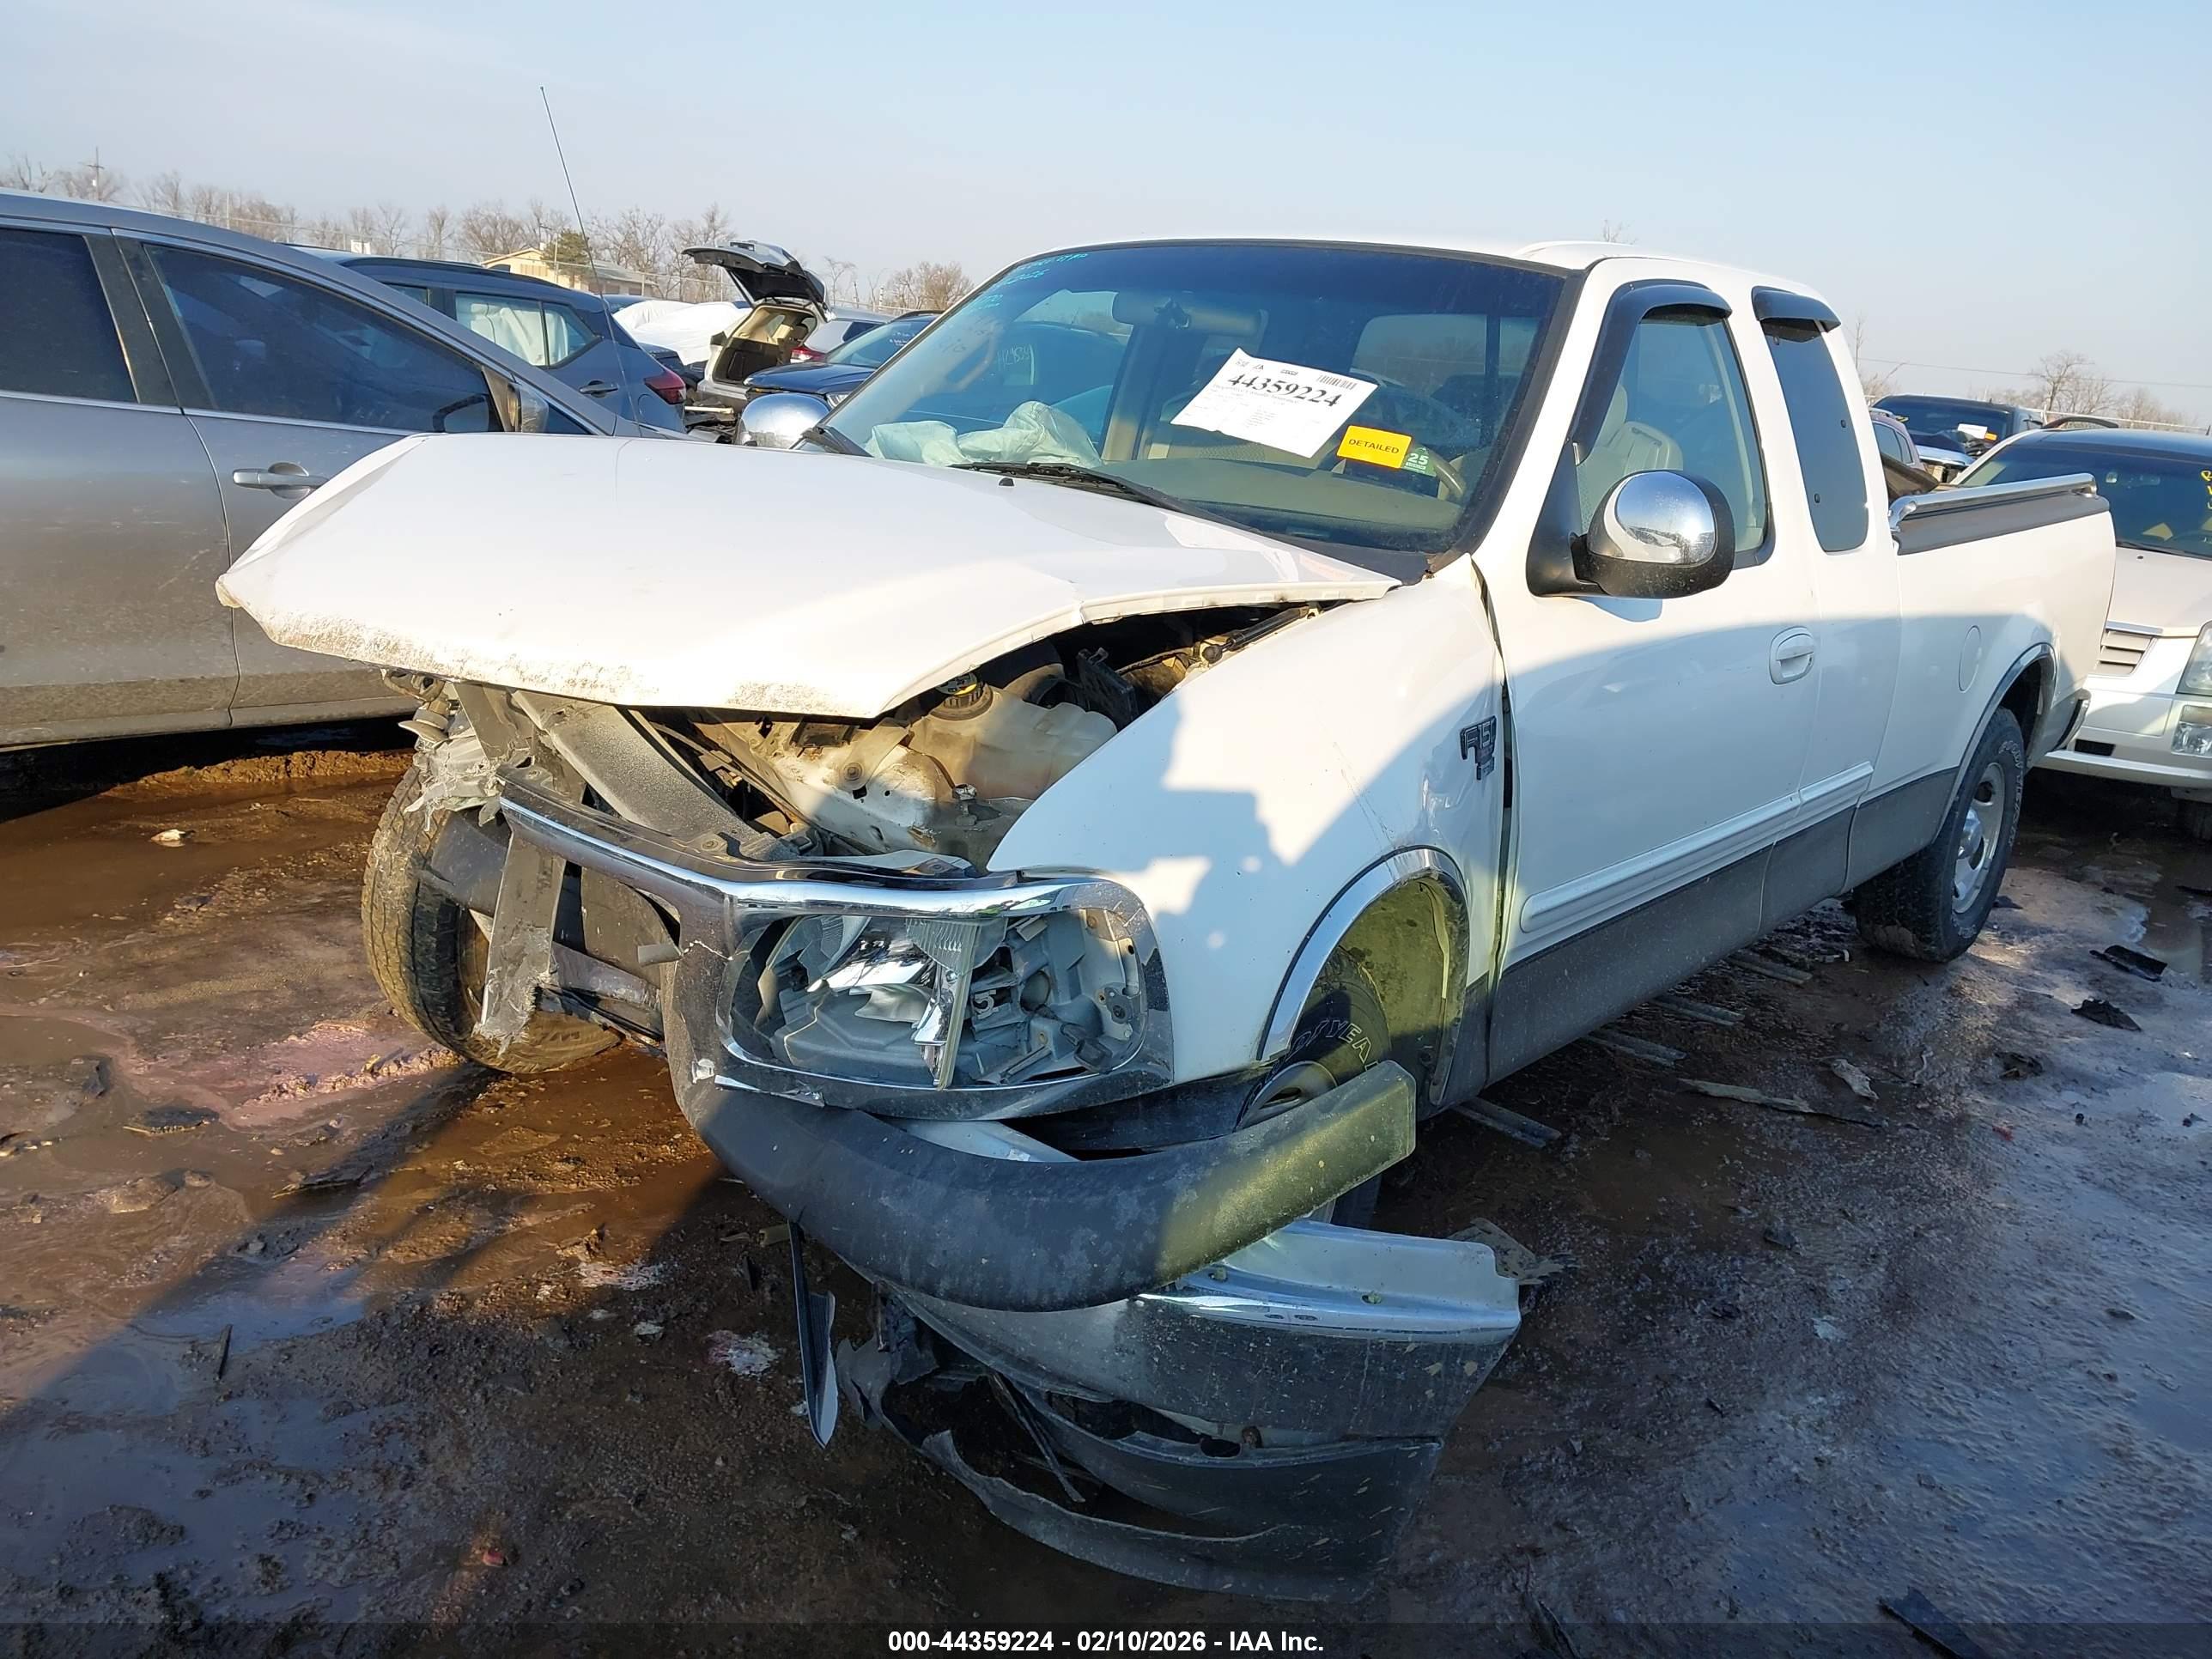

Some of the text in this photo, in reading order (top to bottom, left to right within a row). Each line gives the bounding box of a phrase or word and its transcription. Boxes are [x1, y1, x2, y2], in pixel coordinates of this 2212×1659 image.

[1228, 374, 1342, 407] 44359224
[1348, 438, 1400, 454] DETAILED
[1407, 453, 1430, 465] 25
